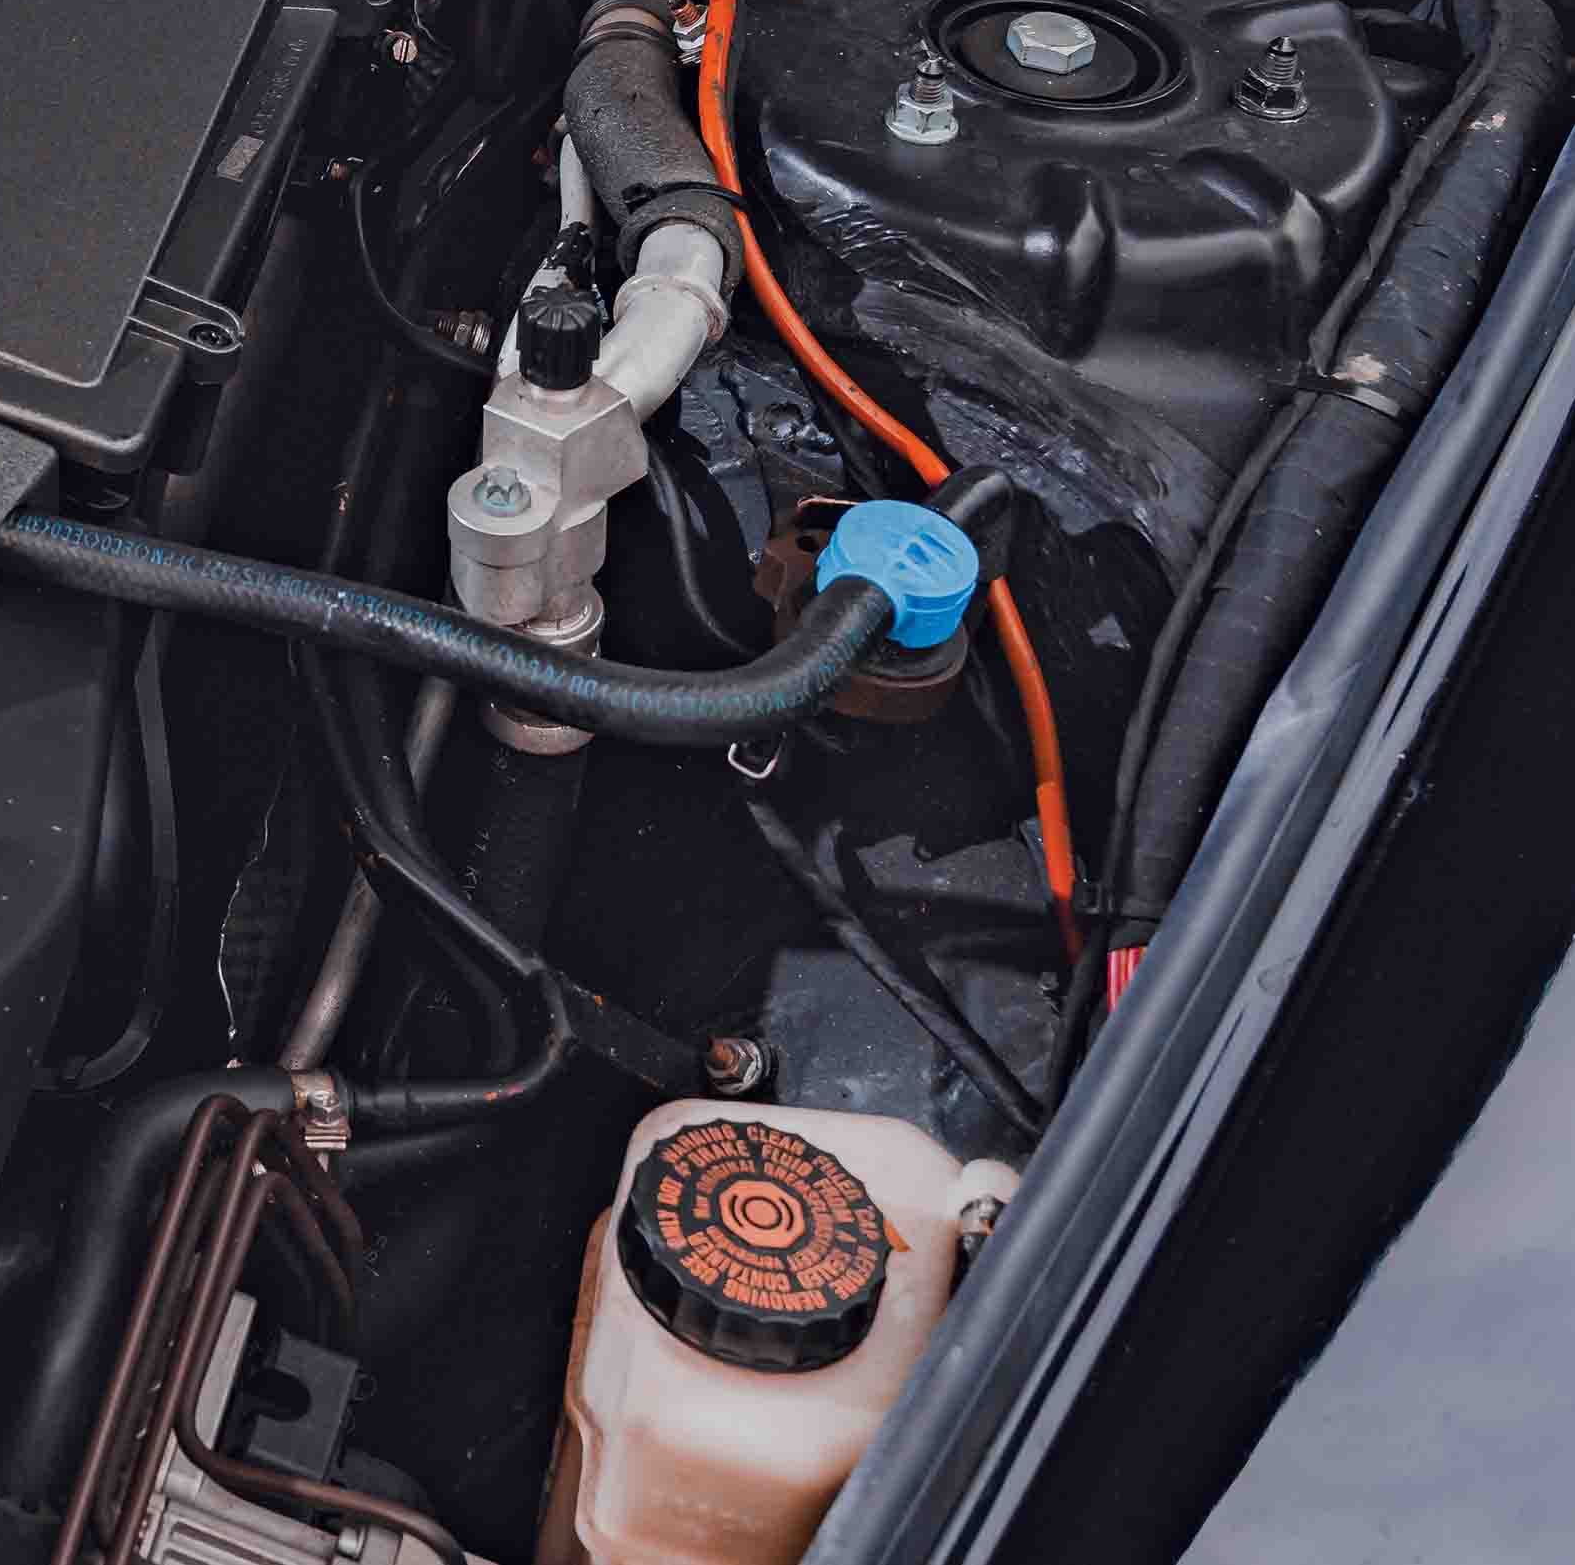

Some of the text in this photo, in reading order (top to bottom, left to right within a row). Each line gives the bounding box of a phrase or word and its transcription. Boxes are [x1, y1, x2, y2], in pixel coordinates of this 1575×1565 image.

[659, 1123, 737, 1164] WARNING
[746, 1124, 806, 1156] CLEAN
[657, 1209, 688, 1250] ONLY
[687, 1139, 750, 1168] BRAKE
[761, 1142, 814, 1178] FLUID
[722, 1277, 828, 1311] REMOVING
